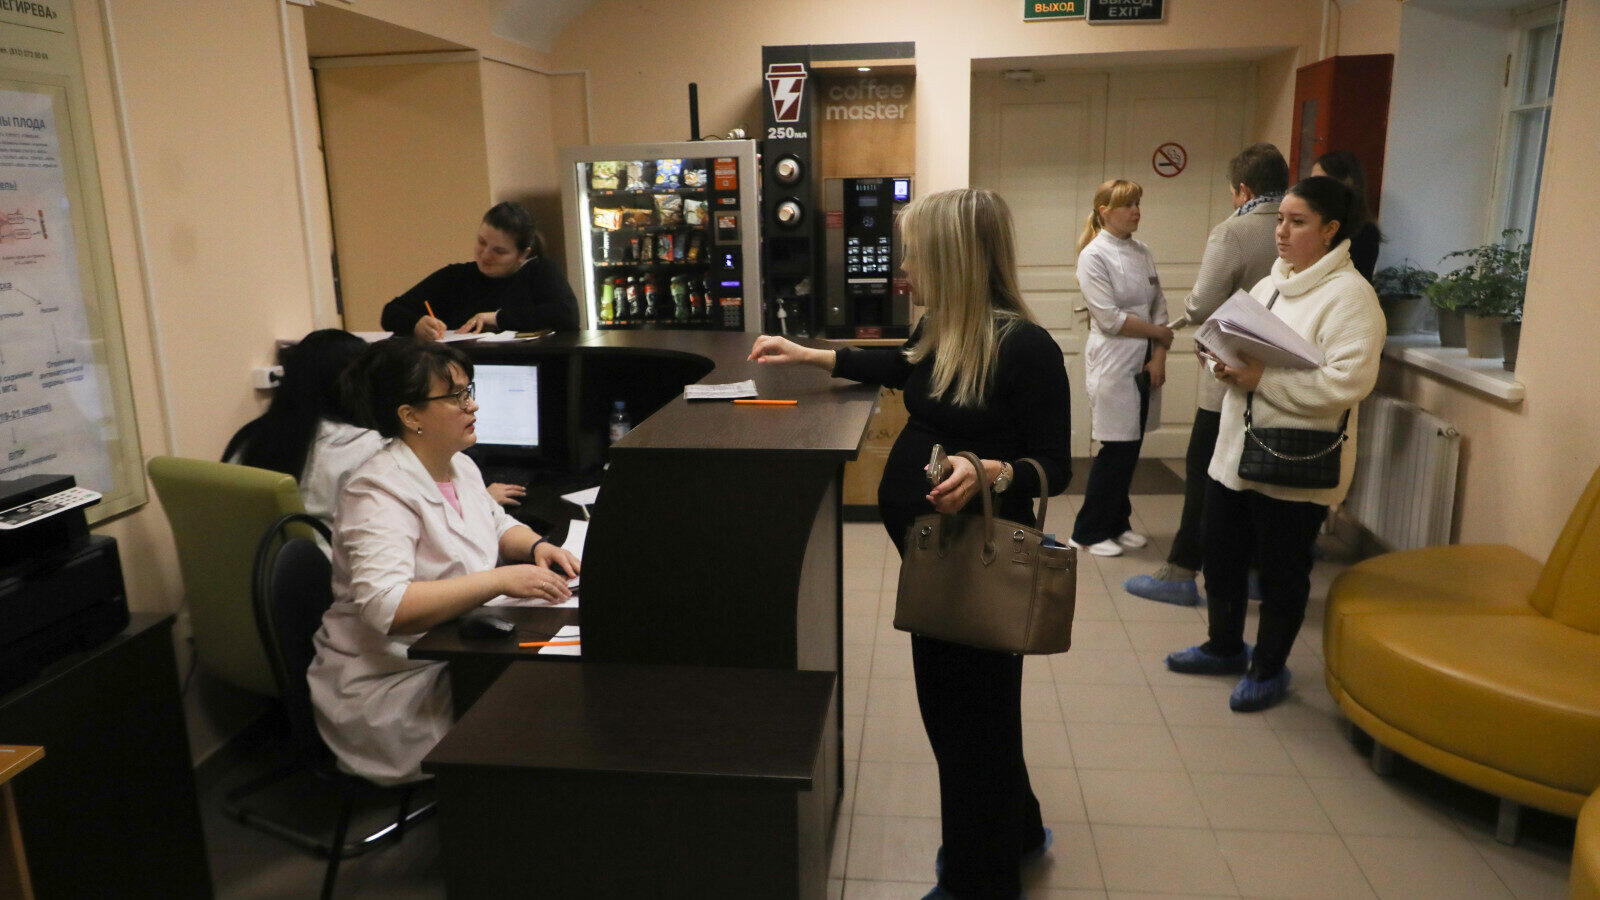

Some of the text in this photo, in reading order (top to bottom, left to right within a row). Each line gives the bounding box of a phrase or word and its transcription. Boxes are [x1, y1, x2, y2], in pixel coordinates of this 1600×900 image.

[1035, 2, 1075, 13] ВЫХОД
[1108, 6, 1140, 17] EXIT
[829, 79, 905, 100] coffee
[826, 102, 908, 120] master
[13, 117, 46, 131] ПЛОДА
[768, 127, 807, 139] 250мл
